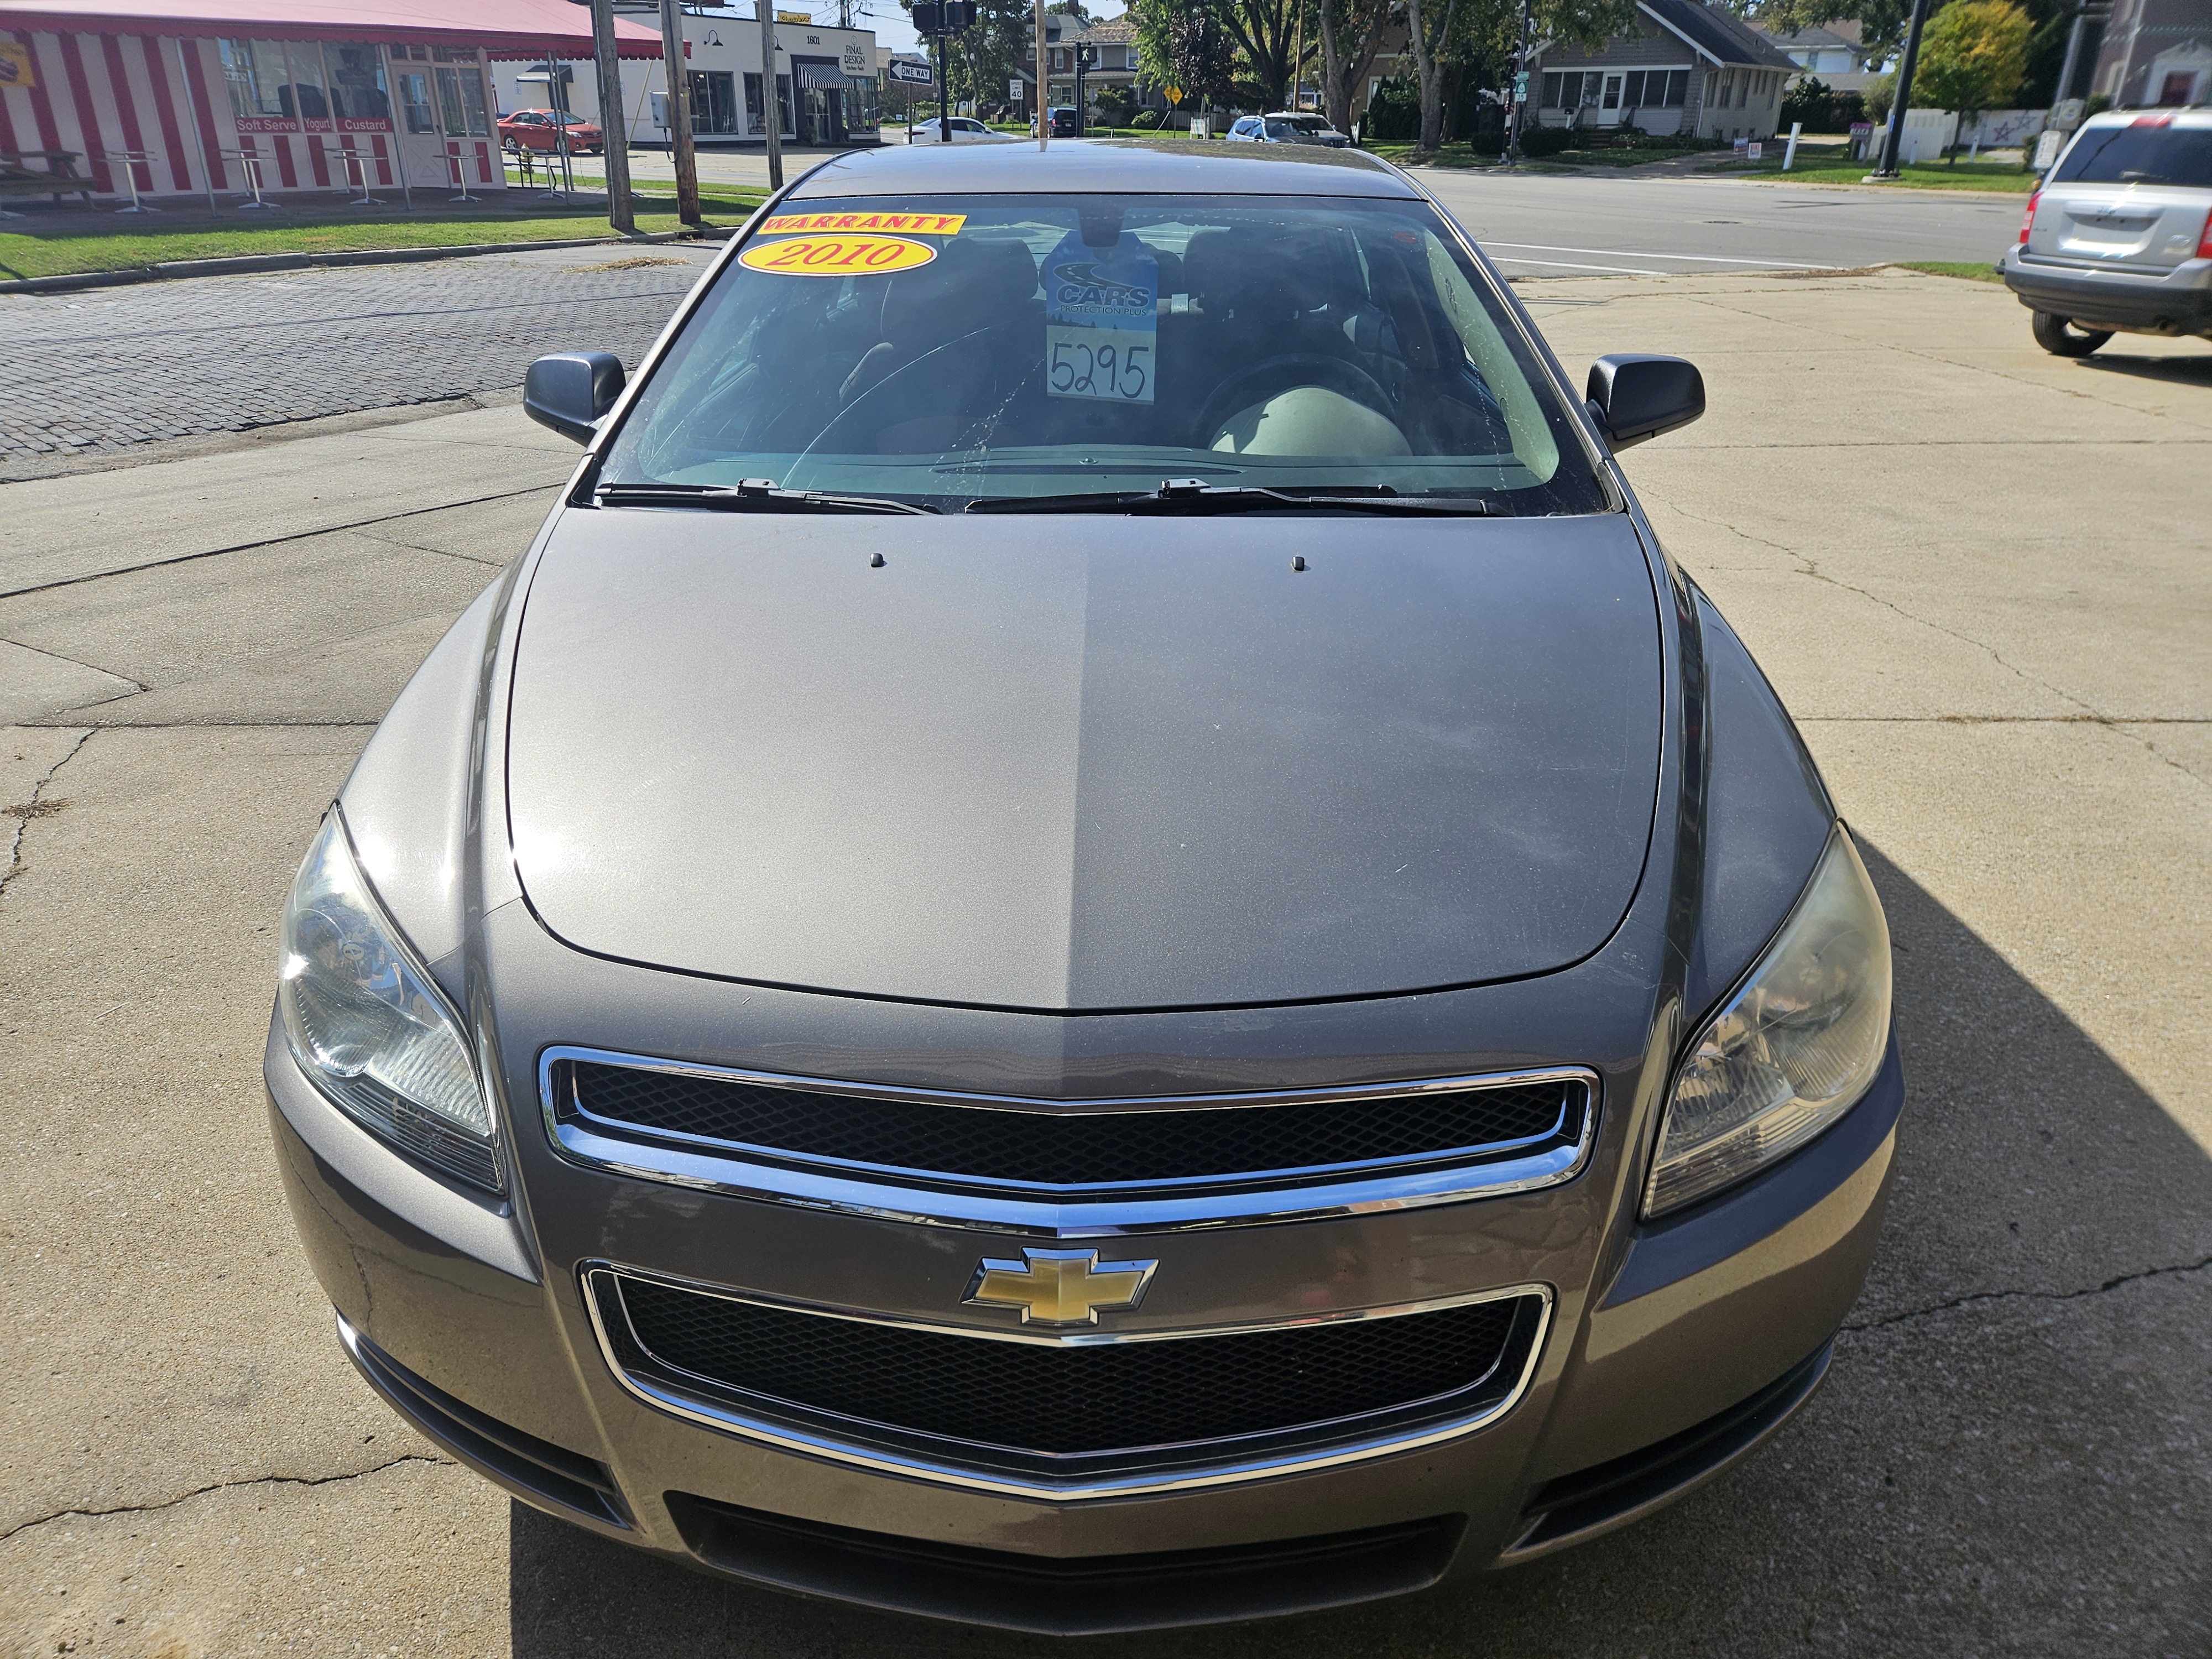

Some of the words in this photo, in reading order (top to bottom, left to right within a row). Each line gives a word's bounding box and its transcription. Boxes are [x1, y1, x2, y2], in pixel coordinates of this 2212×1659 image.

[807, 35, 820, 45] 1601
[846, 45, 863, 55] FINAL
[844, 55, 865, 65] DESIGN
[901, 67, 914, 76] ONE
[916, 69, 928, 78] WAY
[237, 119, 262, 131] Soft
[264, 119, 296, 131] Serve
[304, 117, 331, 132] Yogurt
[345, 119, 386, 130] Custard
[764, 215, 961, 231] WARRANTY
[765, 243, 906, 266] 2010
[1060, 305, 1121, 315] PROTECTION
[1124, 308, 1146, 316] PLUS
[1051, 342, 1149, 399] 5295
